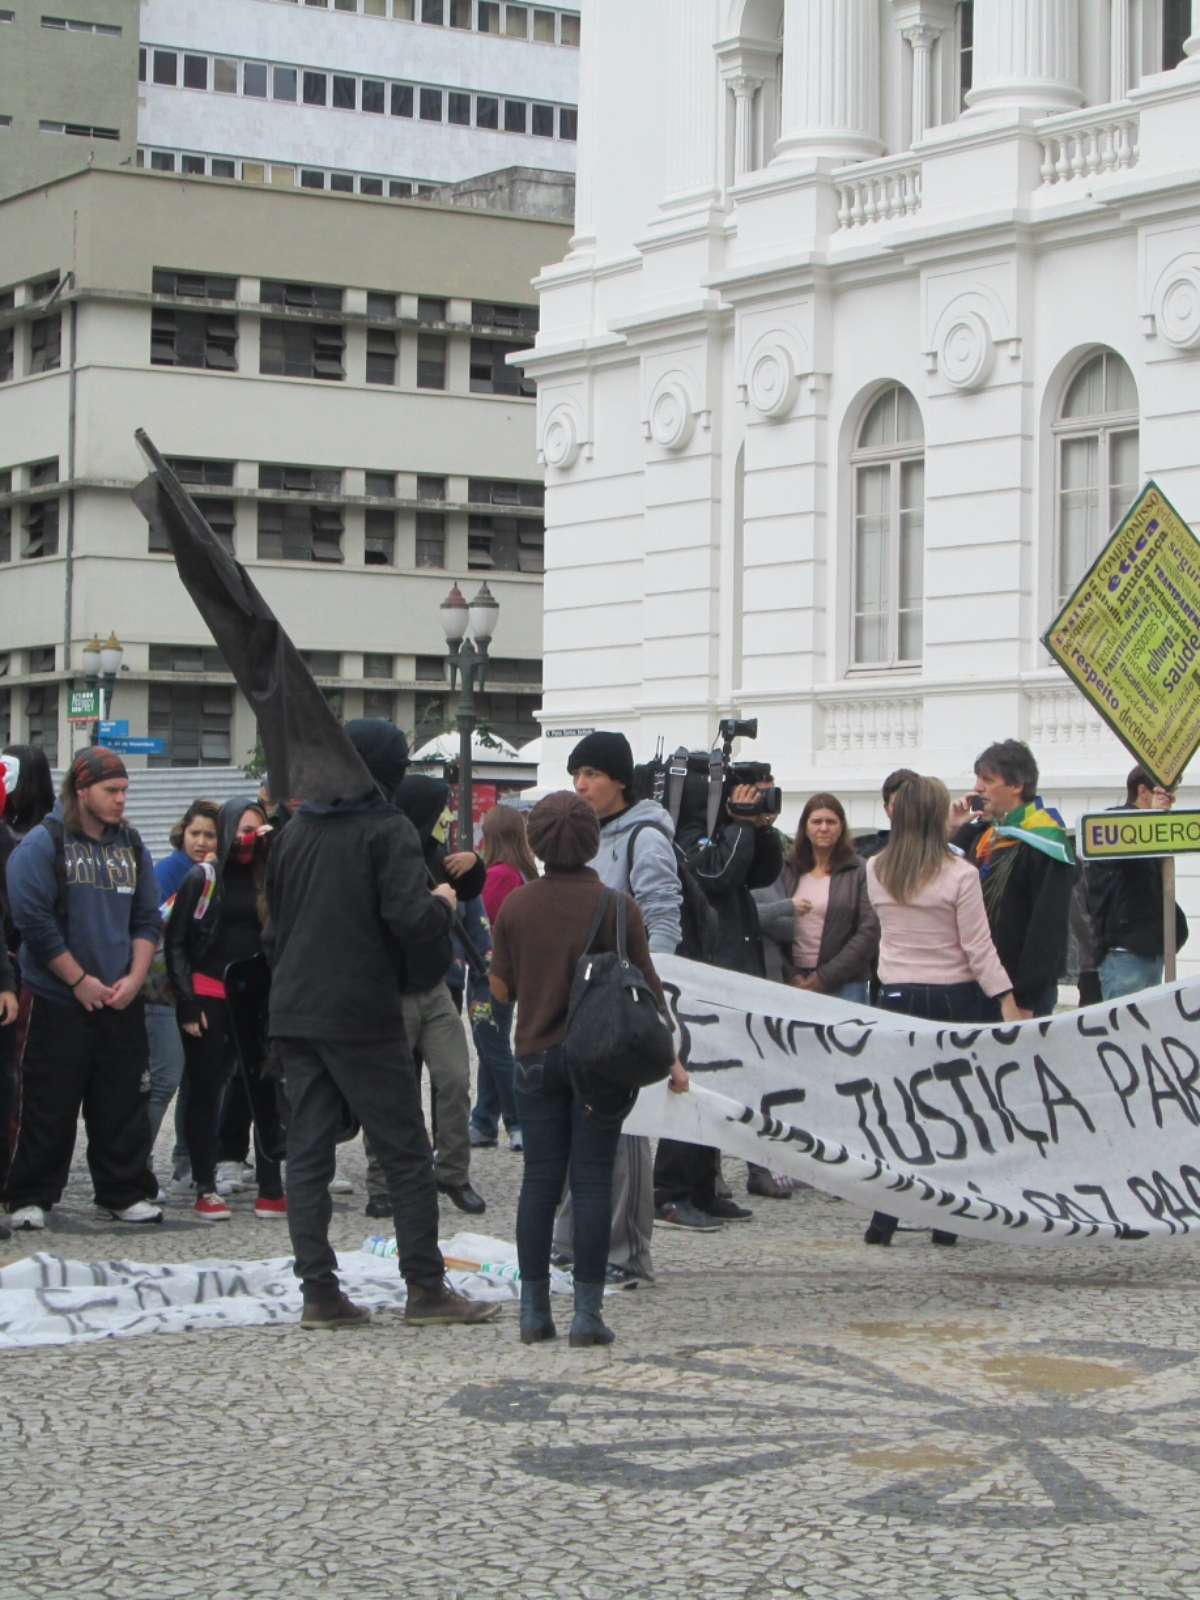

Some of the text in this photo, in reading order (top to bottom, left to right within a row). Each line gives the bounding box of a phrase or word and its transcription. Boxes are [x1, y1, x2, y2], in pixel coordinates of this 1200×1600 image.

[1097, 490, 1158, 582] COMPROMISSO
[1108, 518, 1159, 592] ética
[1117, 531, 1168, 605] mudança
[1138, 585, 1180, 641] escolas
[1144, 574, 1191, 636] oportunidades
[1131, 619, 1159, 660] esportes
[1147, 635, 1174, 675] cultura
[1162, 634, 1200, 693] saúde
[1071, 647, 1119, 710] respeito
[1120, 707, 1158, 759] decência
